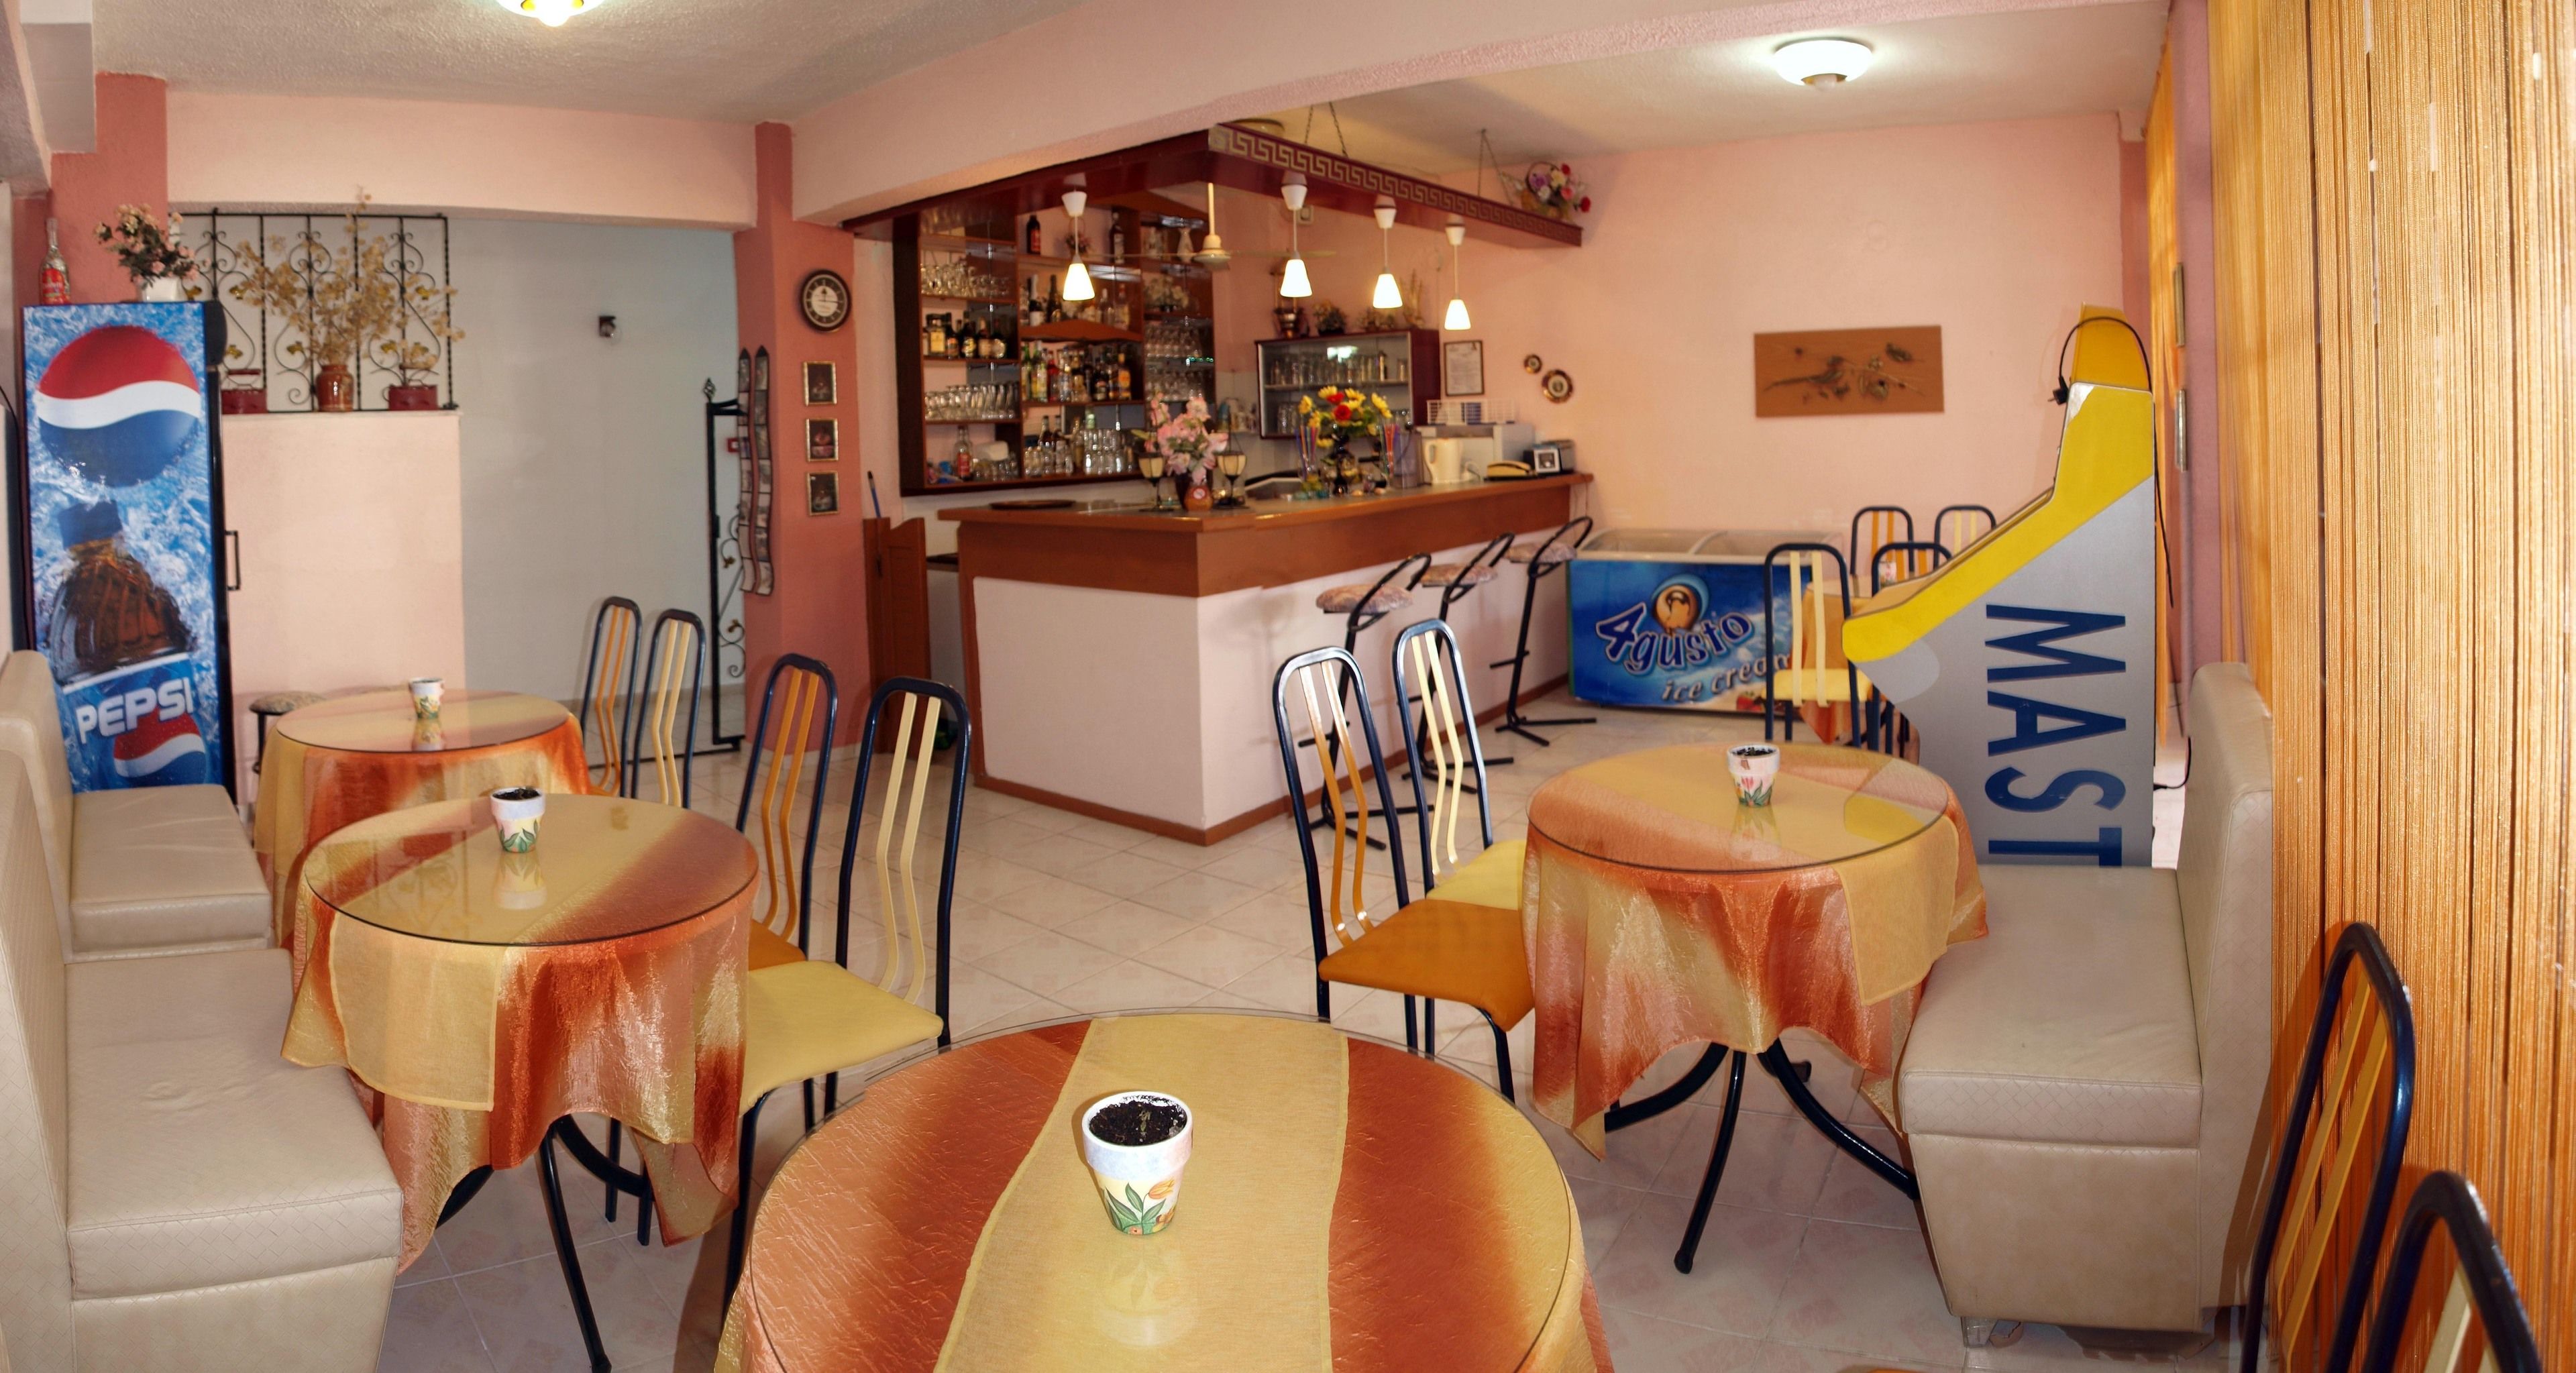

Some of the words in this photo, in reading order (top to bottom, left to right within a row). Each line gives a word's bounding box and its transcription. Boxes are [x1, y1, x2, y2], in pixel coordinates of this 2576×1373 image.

[76, 677, 194, 745] PEPSI
[1662, 679, 1703, 701] ice
[1985, 604, 2127, 868] MAST
